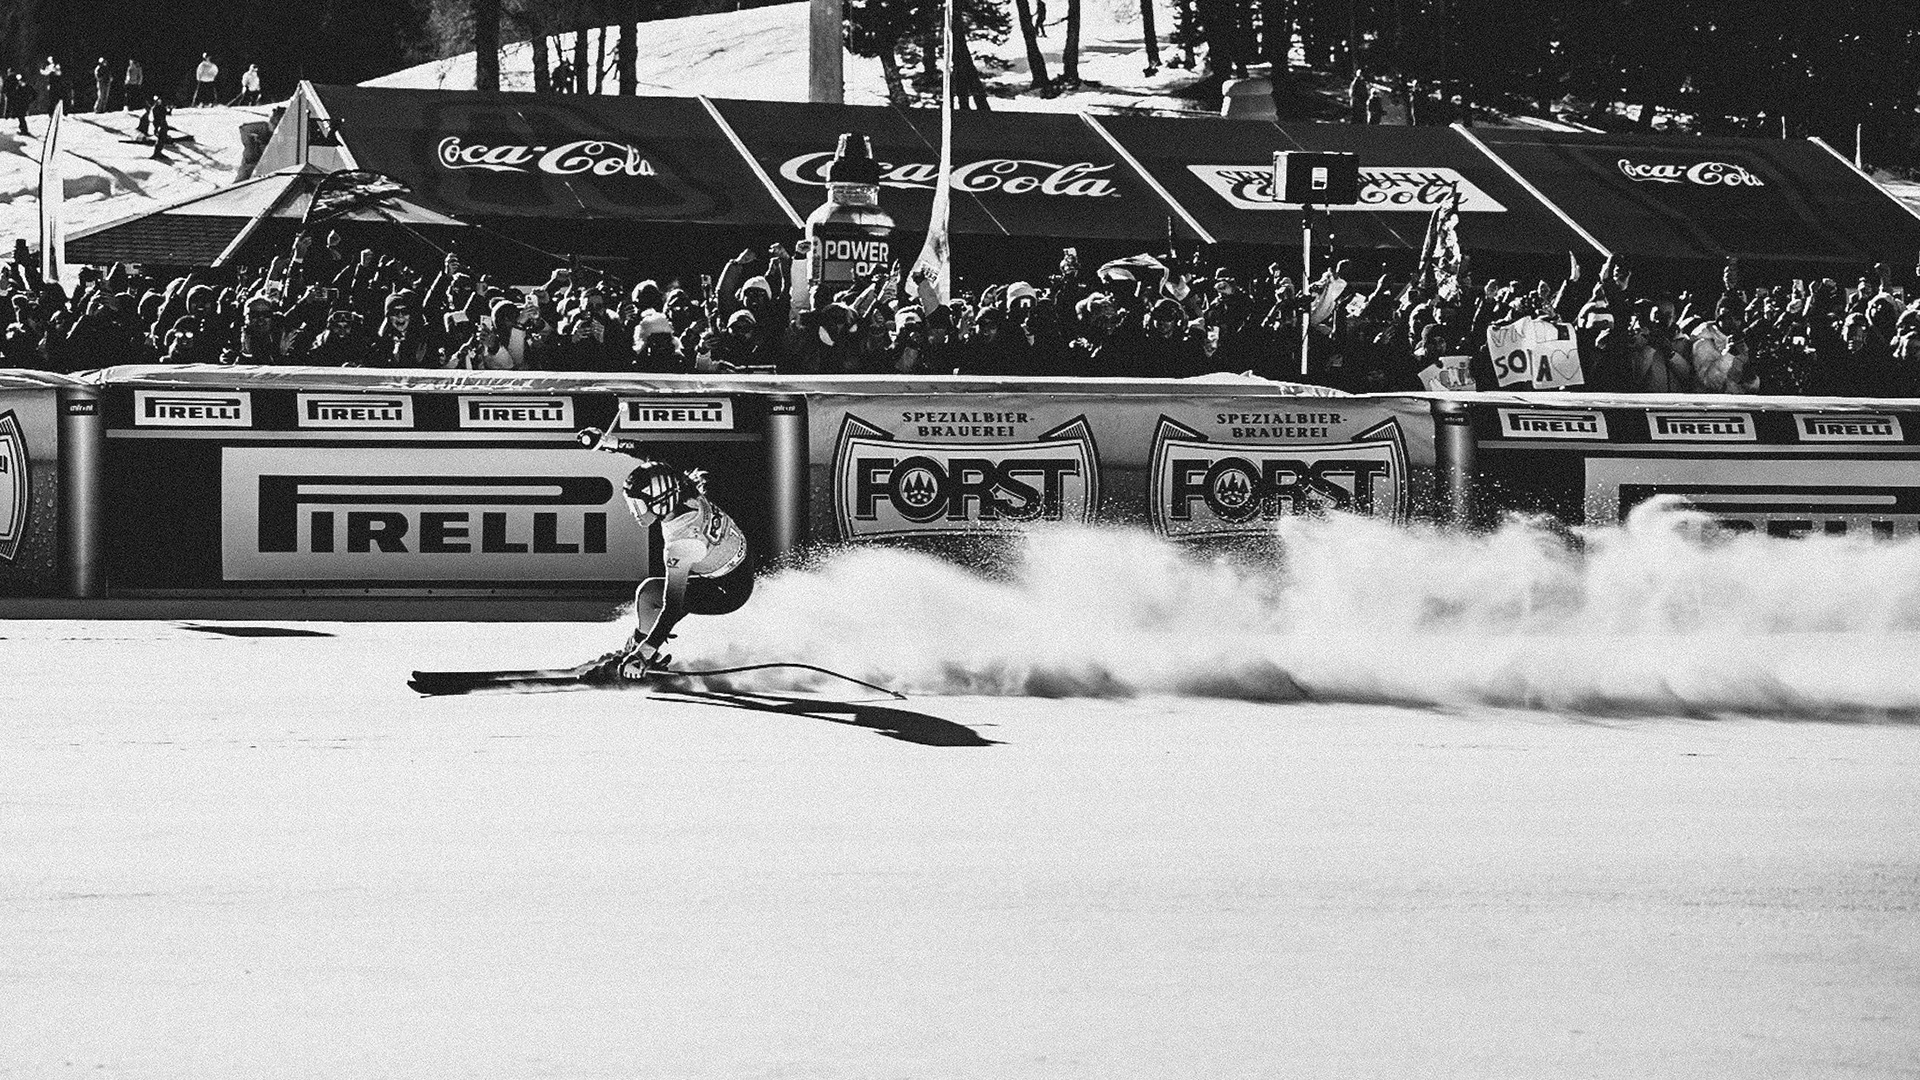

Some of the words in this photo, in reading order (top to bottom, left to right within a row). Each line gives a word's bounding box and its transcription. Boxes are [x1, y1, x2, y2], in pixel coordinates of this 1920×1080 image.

[437, 136, 657, 176] Coca-Cola
[1617, 158, 1765, 187] Coca-Cola
[825, 240, 890, 262] POWER
[144, 397, 241, 419] PIRELLI
[306, 399, 403, 420] PIRELLI
[467, 400, 564, 421] PIRELLI
[628, 402, 723, 422] PIRELLI
[902, 411, 1035, 423] SPEZIALBIER-
[1216, 413, 1348, 424] SPEZIALBIER-
[918, 426, 1015, 437] BRAUEREI
[1233, 427, 1329, 438] BRAUEREI
[1508, 413, 1598, 433] PIRELLI
[1657, 414, 1745, 434] PIRELLI
[1804, 416, 1893, 436] PIRELLI
[854, 456, 1080, 523] FORST
[1170, 457, 1390, 522] FORST
[258, 474, 614, 553] PIRELLI
